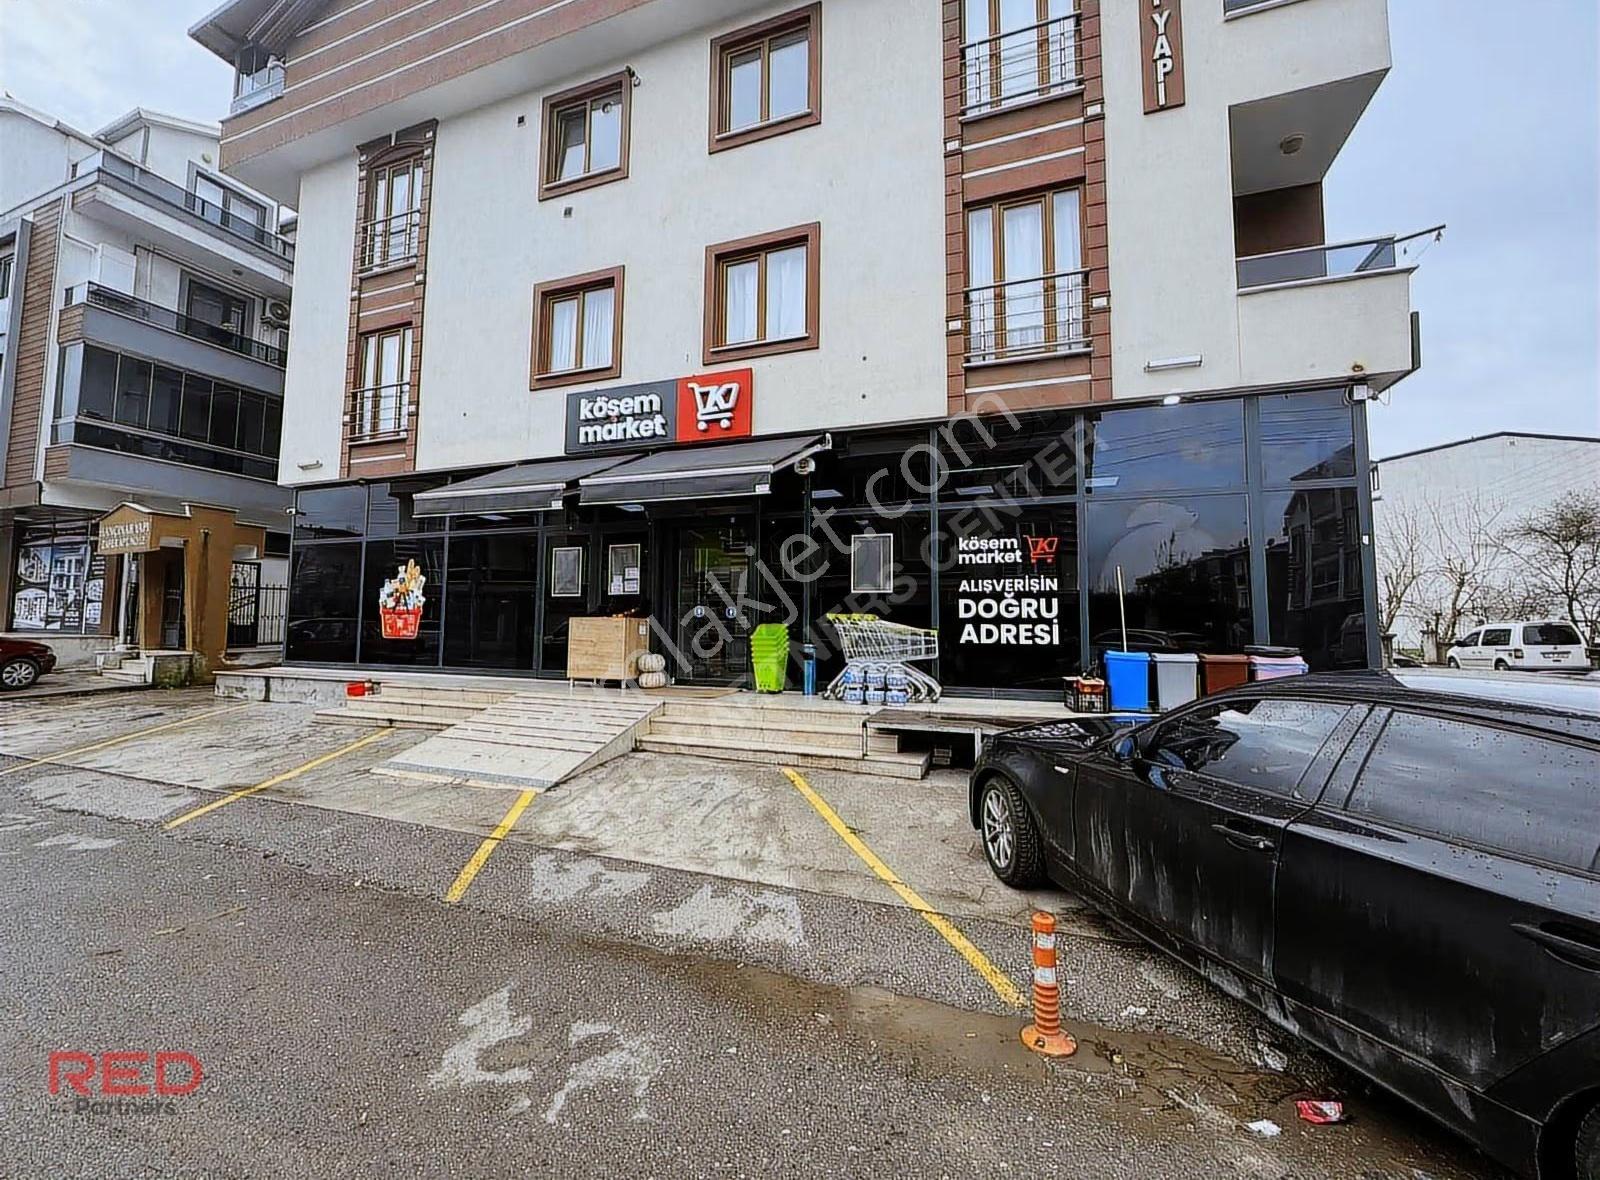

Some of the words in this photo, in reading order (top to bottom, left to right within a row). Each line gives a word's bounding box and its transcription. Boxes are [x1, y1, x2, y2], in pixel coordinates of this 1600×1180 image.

[1151, 9, 1174, 106] YAPI
[579, 414, 666, 444] market
[958, 549, 1022, 565] market
[959, 575, 1058, 593] ALIŞVERİŞİN
[958, 591, 1059, 619] DOĞRU
[959, 618, 1060, 645] ADRESİ
